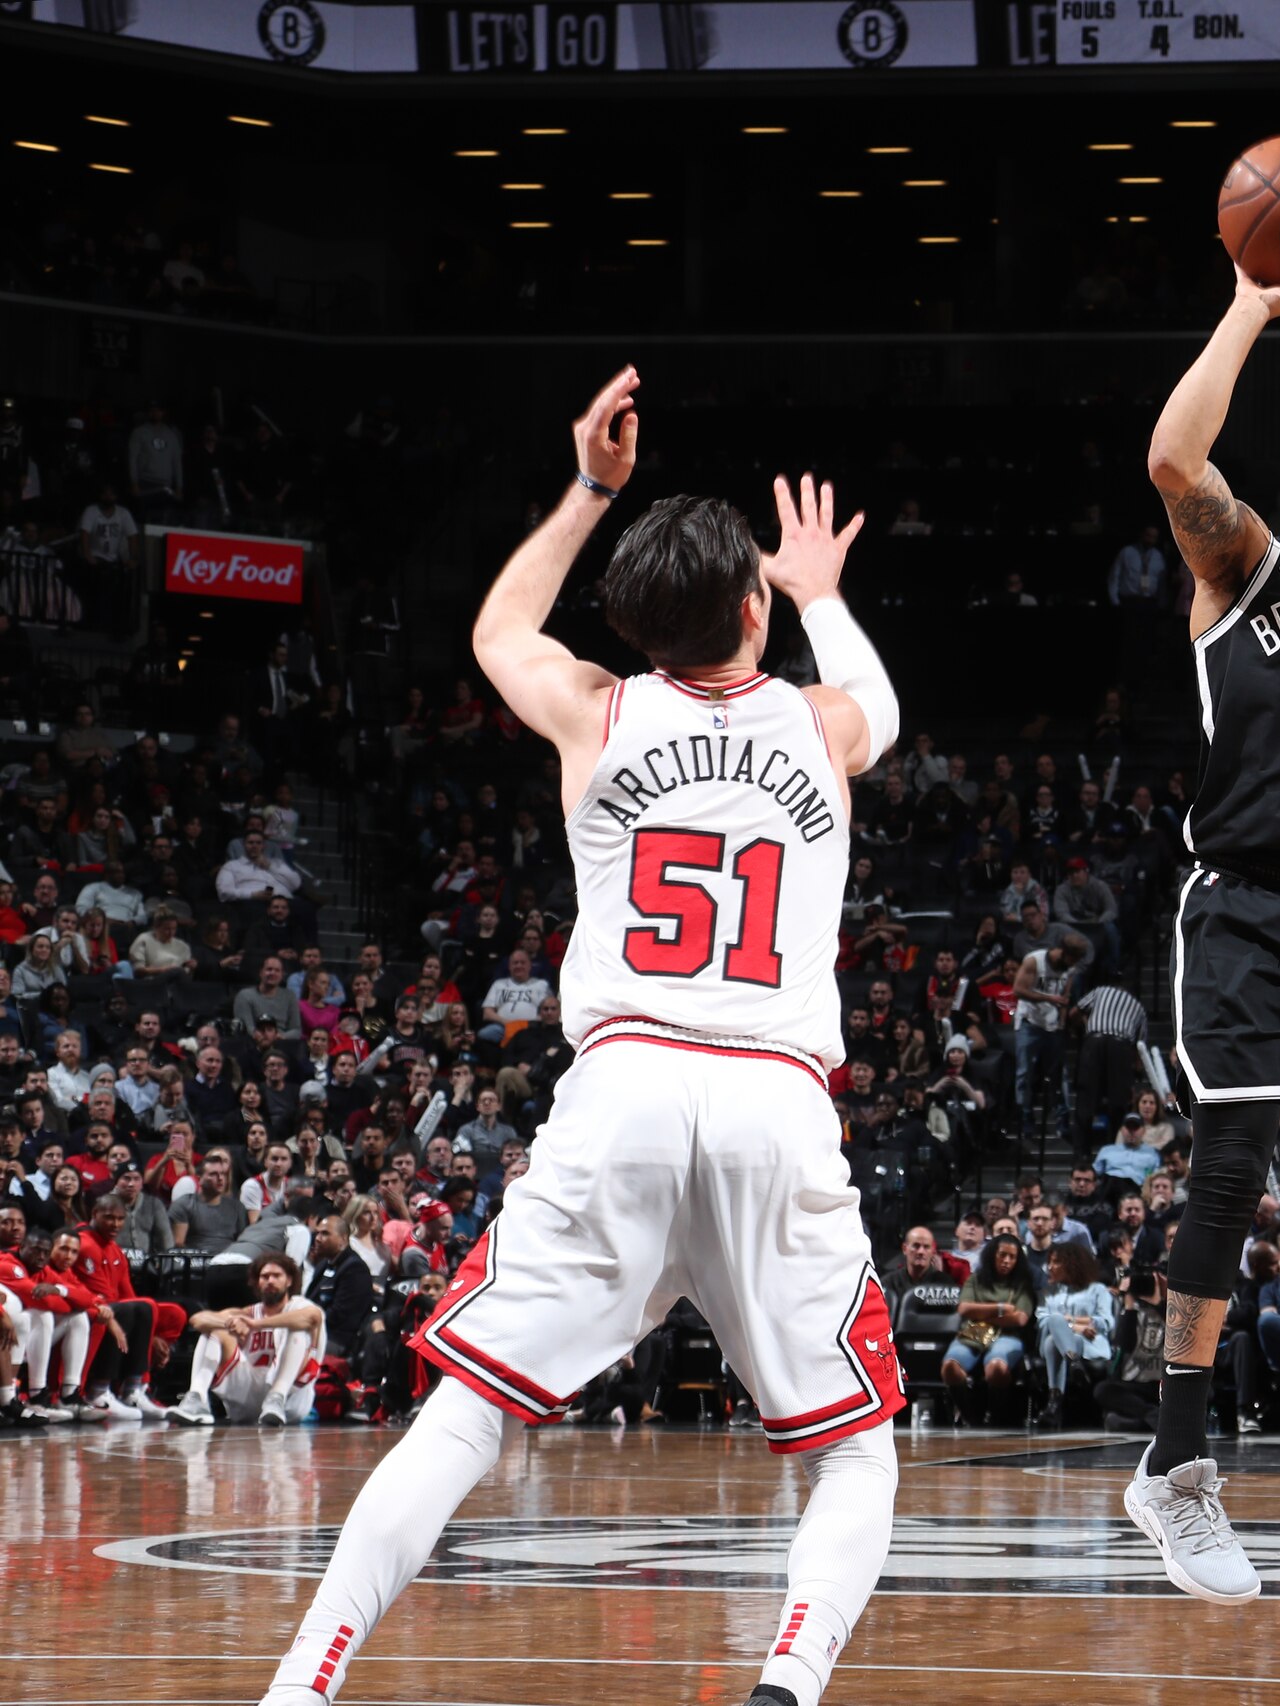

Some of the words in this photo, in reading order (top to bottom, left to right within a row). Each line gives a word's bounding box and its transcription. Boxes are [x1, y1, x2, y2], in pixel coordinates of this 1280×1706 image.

[1062, 0, 1116, 20] FOULS
[447, 10, 530, 71] LET'S
[555, 14, 607, 67] GO
[1081, 27, 1098, 57] 5
[1150, 25, 1169, 56] 4
[1193, 15, 1245, 39] BON.
[597, 735, 834, 844] ARCIDIACONO
[622, 827, 785, 989] 51
[914, 1286, 960, 1300] QATAR
